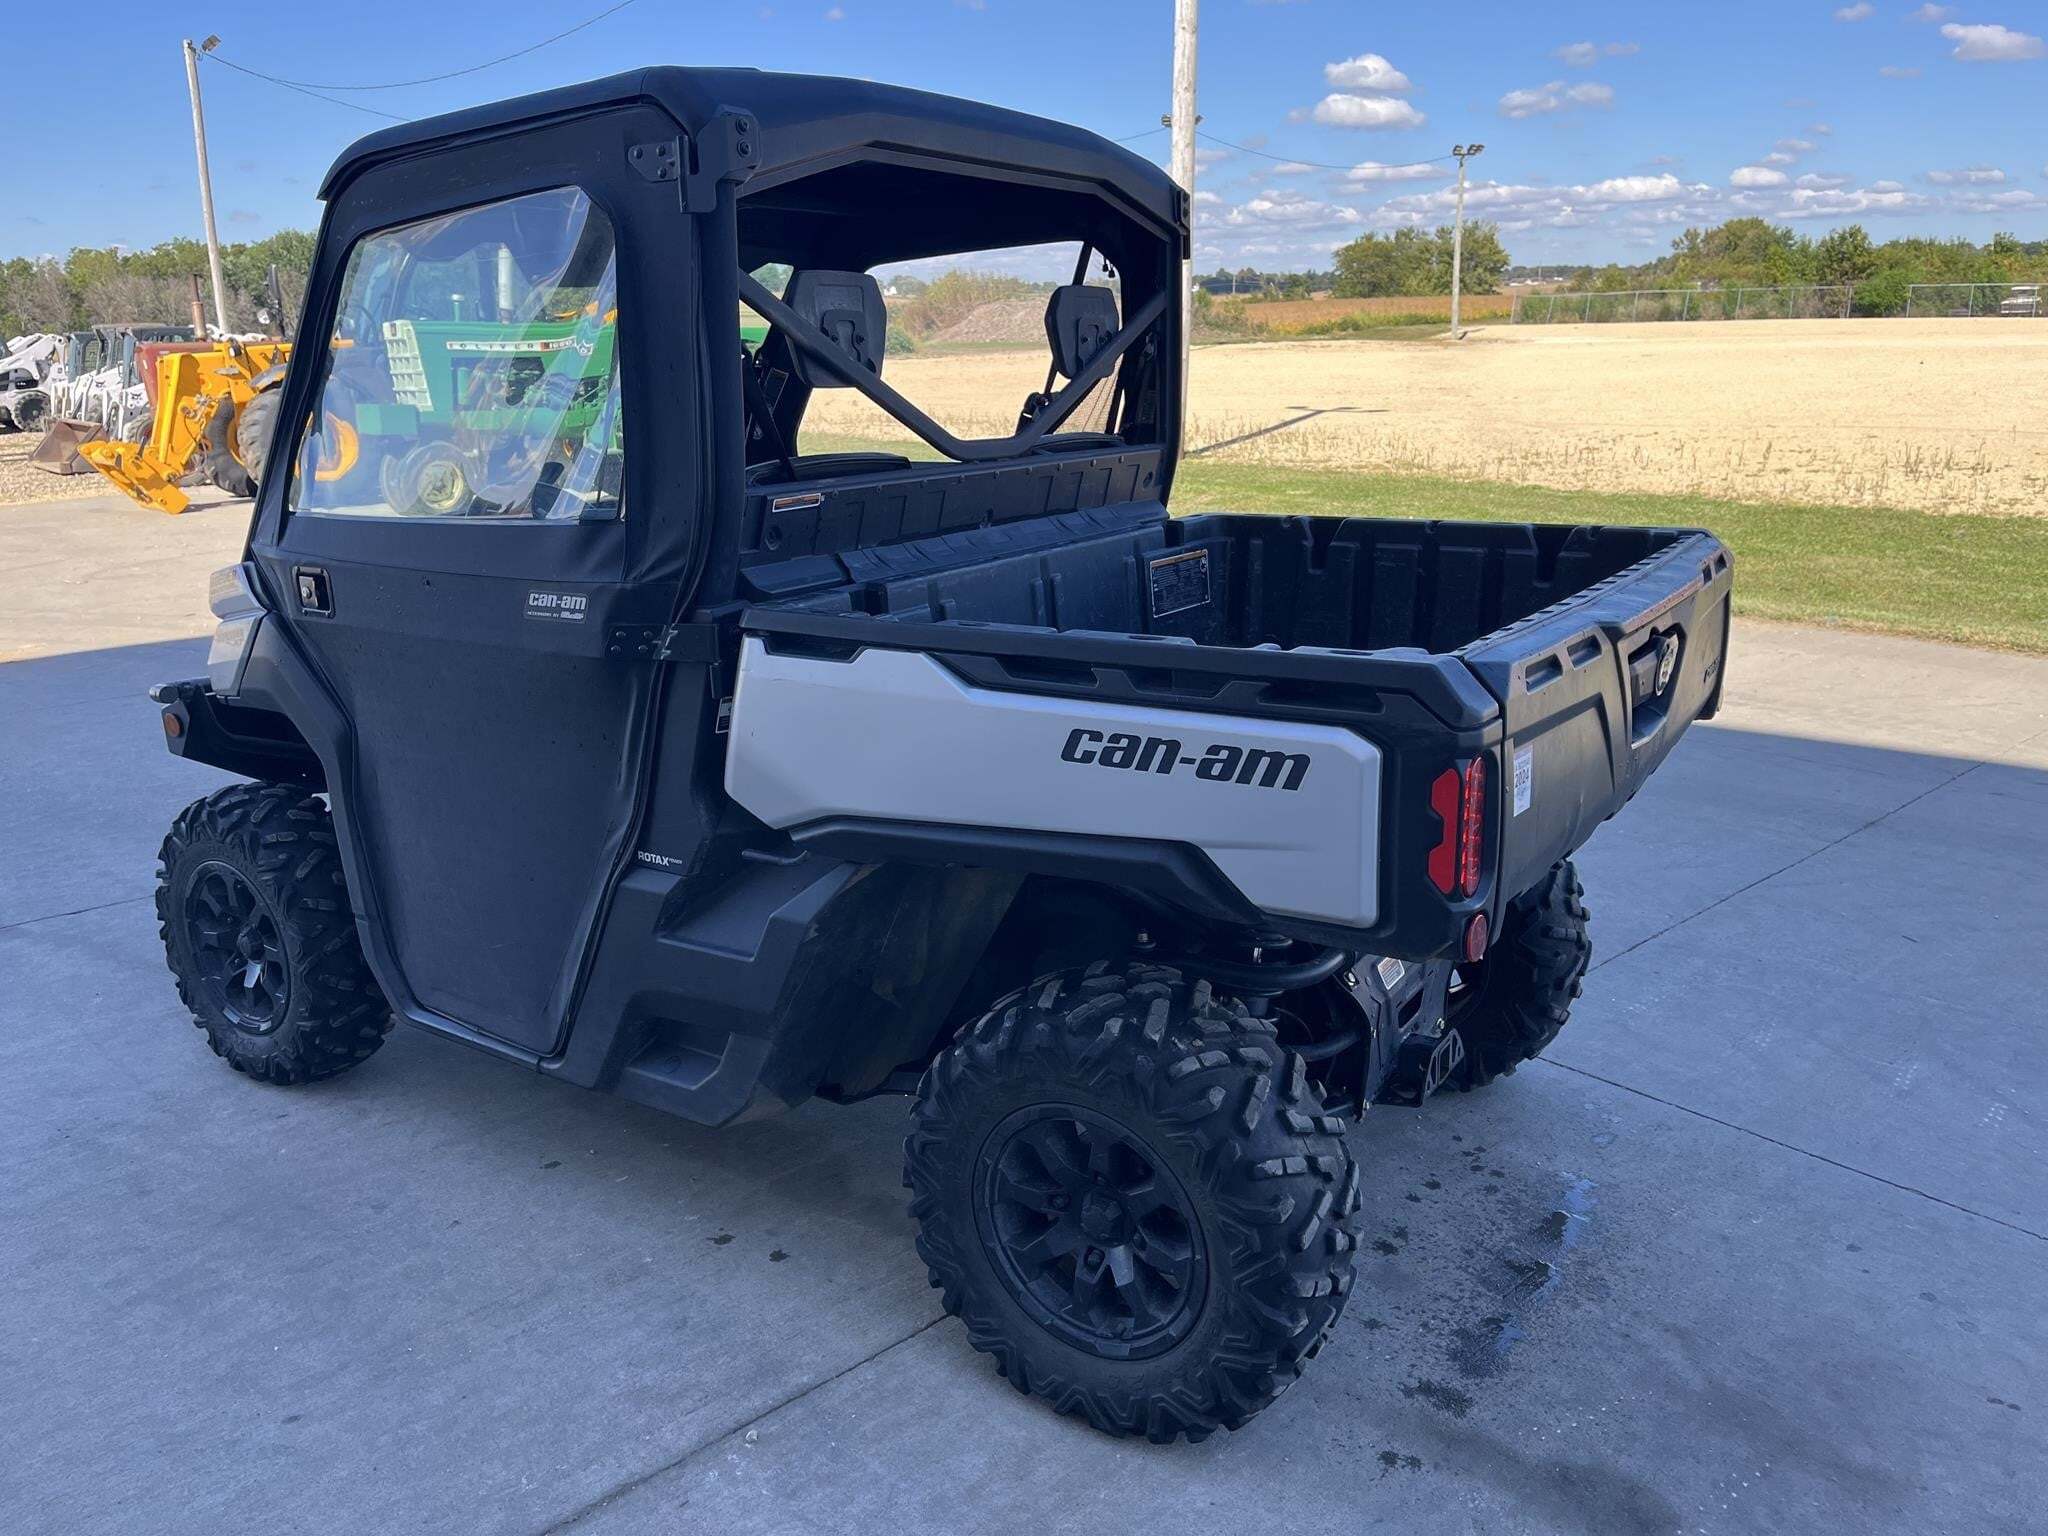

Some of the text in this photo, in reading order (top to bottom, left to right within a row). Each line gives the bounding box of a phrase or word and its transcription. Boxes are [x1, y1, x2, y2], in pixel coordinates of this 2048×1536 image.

[460, 342, 534, 350] OLIVER
[528, 593, 587, 610] can-am
[1060, 728, 1312, 791] can-am
[638, 850, 669, 866] ROTAX
